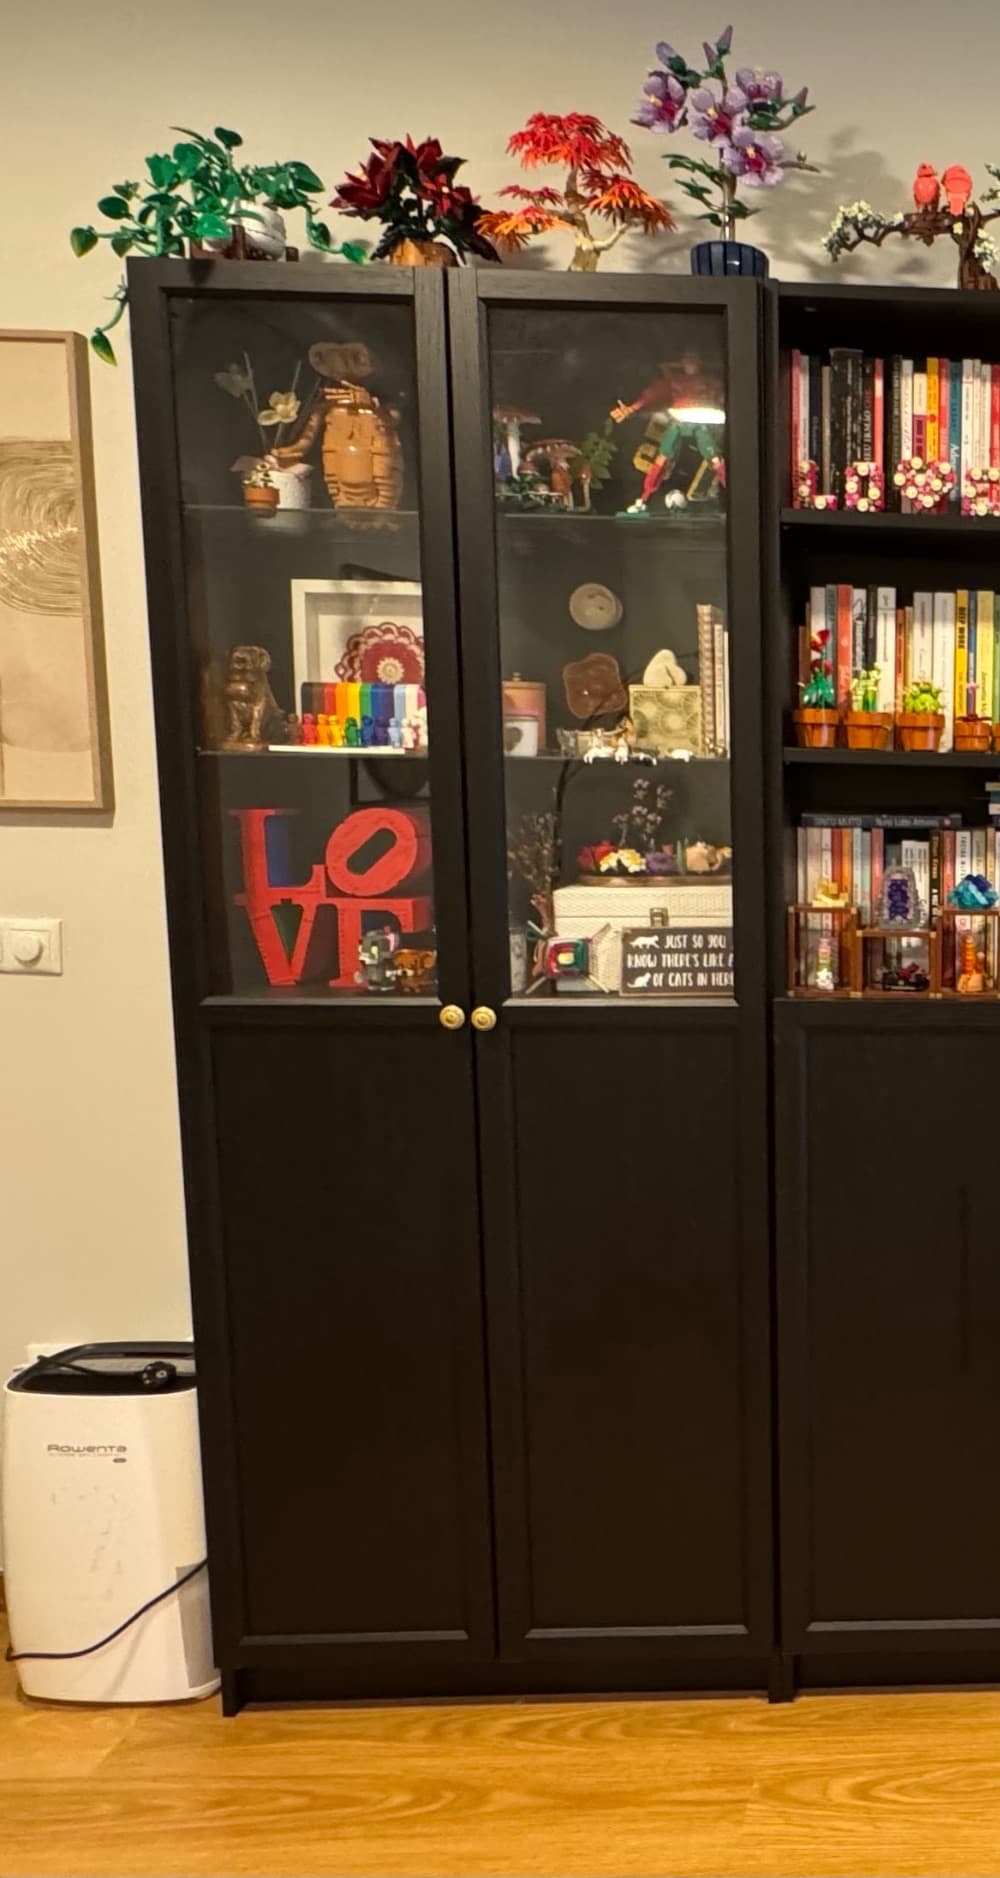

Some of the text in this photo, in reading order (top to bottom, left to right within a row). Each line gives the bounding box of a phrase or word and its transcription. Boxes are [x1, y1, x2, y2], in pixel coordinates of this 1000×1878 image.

[664, 934, 727, 949] JUST SO YOU
[627, 953, 657, 968] KNOW
[662, 952, 699, 968] THERE'S
[703, 952, 724, 968] LIKE
[652, 972, 664, 987] OF
[668, 972, 693, 987] CATS
[697, 972, 708, 987] IN
[47, 1443, 128, 1453] Rowenta
